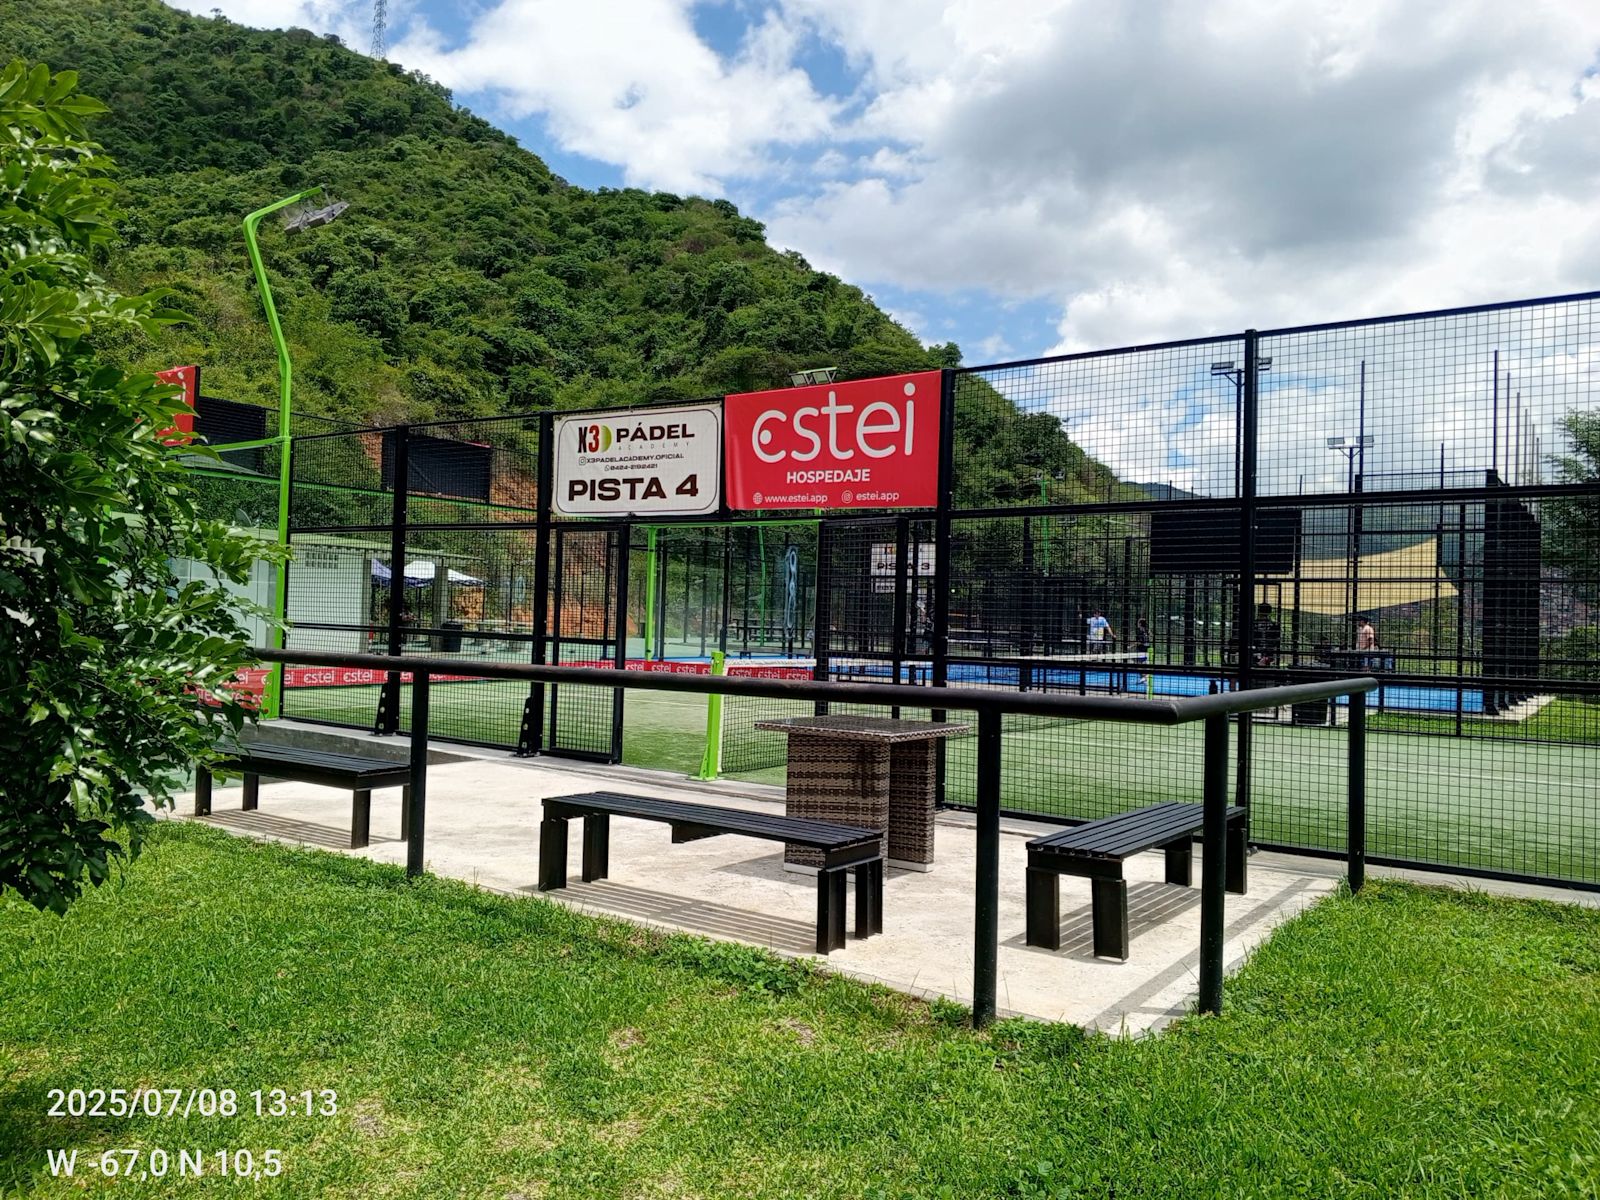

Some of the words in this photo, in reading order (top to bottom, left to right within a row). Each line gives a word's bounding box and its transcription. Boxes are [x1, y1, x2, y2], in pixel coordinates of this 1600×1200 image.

[751, 382, 916, 463] estei
[616, 422, 695, 443] PÁDEL
[786, 468, 871, 484] HOSPEDAJE
[568, 477, 667, 501] PISTA
[675, 474, 699, 497] 4
[764, 492, 828, 504] www.estei.app
[855, 490, 900, 502] estei.app
[651, 664, 671, 673] estei
[303, 670, 335, 684] estei
[343, 669, 373, 683] estei
